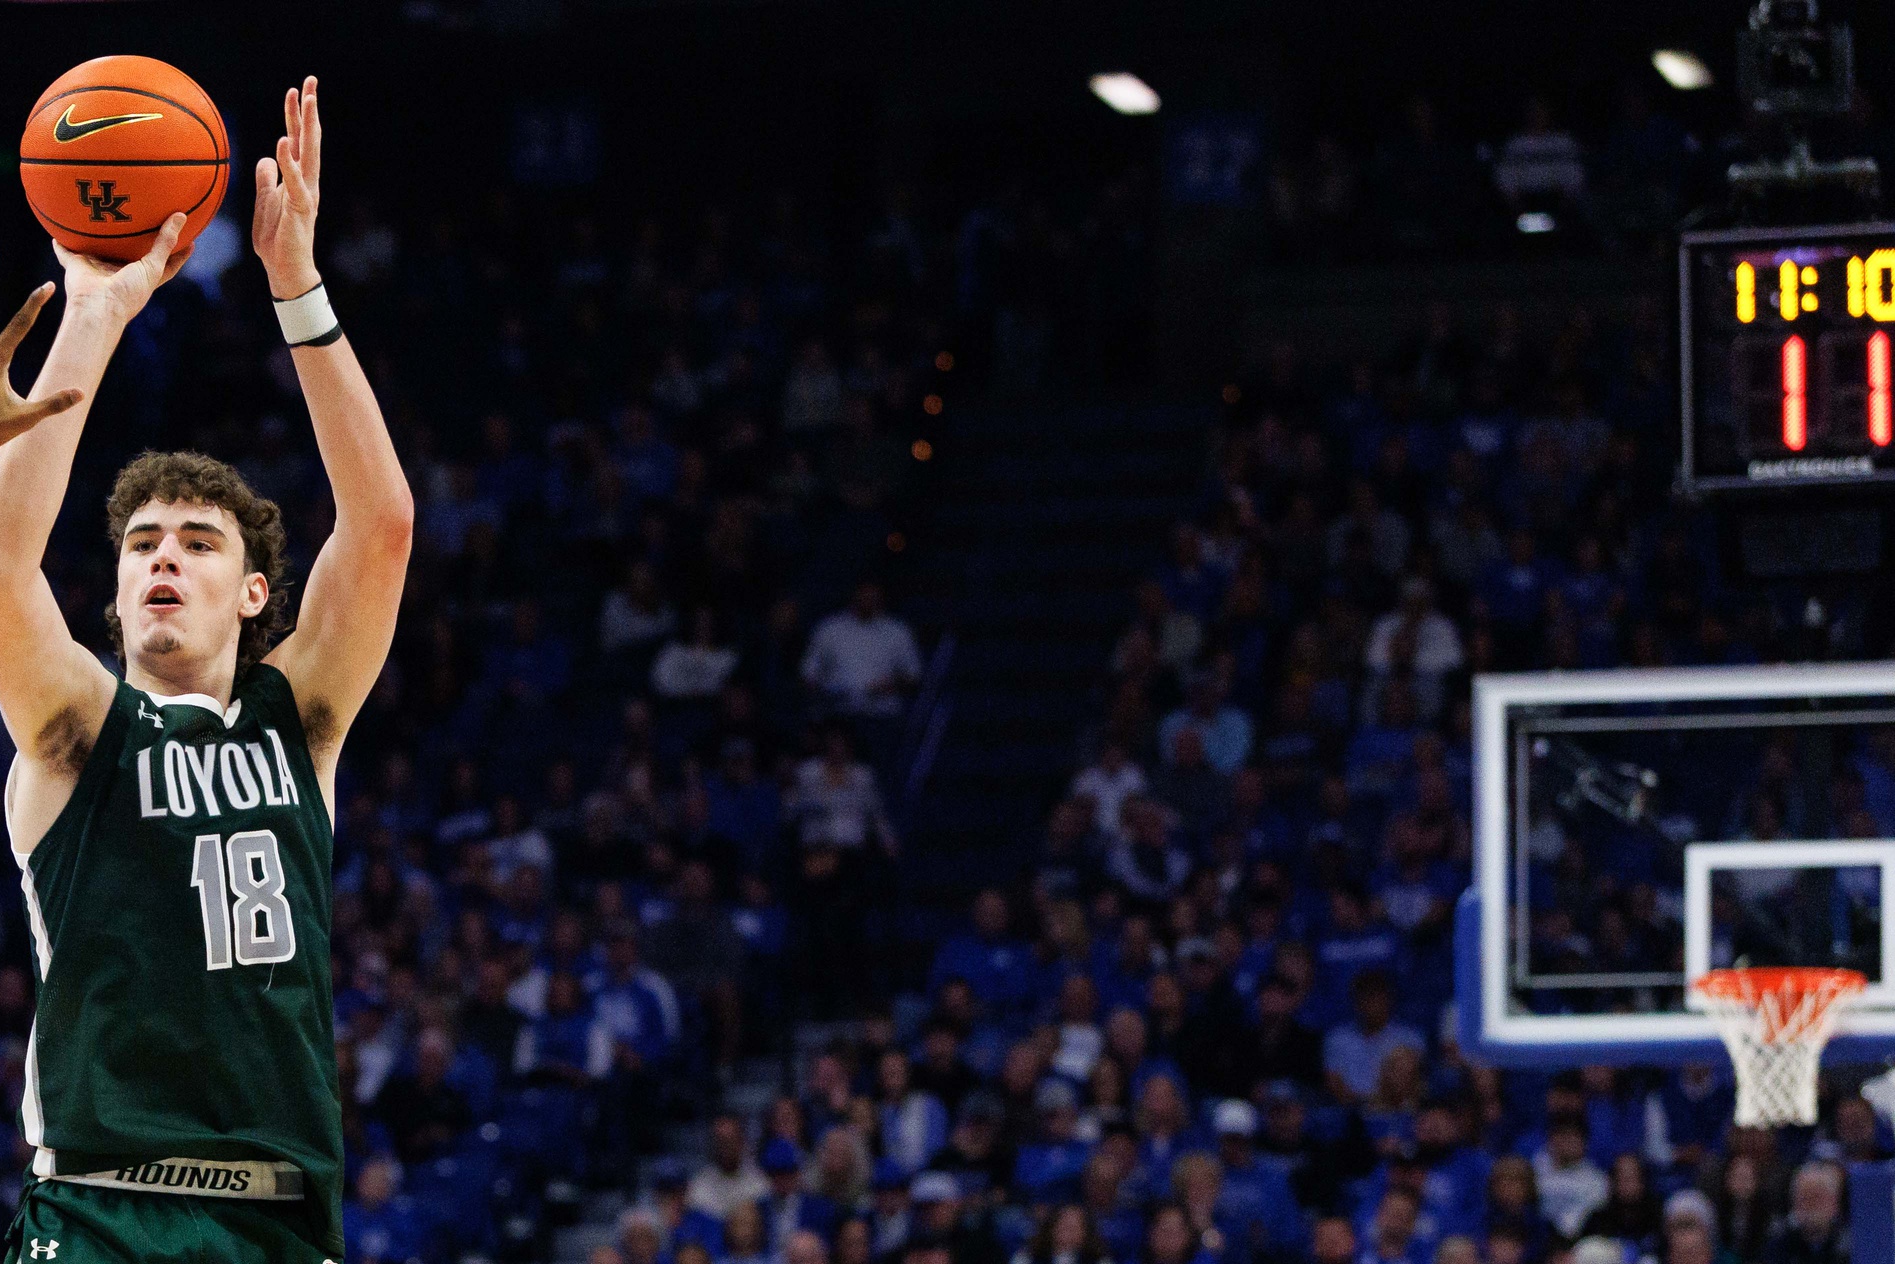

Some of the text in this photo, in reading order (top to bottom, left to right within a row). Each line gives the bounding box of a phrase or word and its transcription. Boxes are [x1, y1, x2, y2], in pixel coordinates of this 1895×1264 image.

[75, 179, 132, 222] UK
[136, 729, 300, 818] LOYOLA
[190, 829, 297, 971] 18
